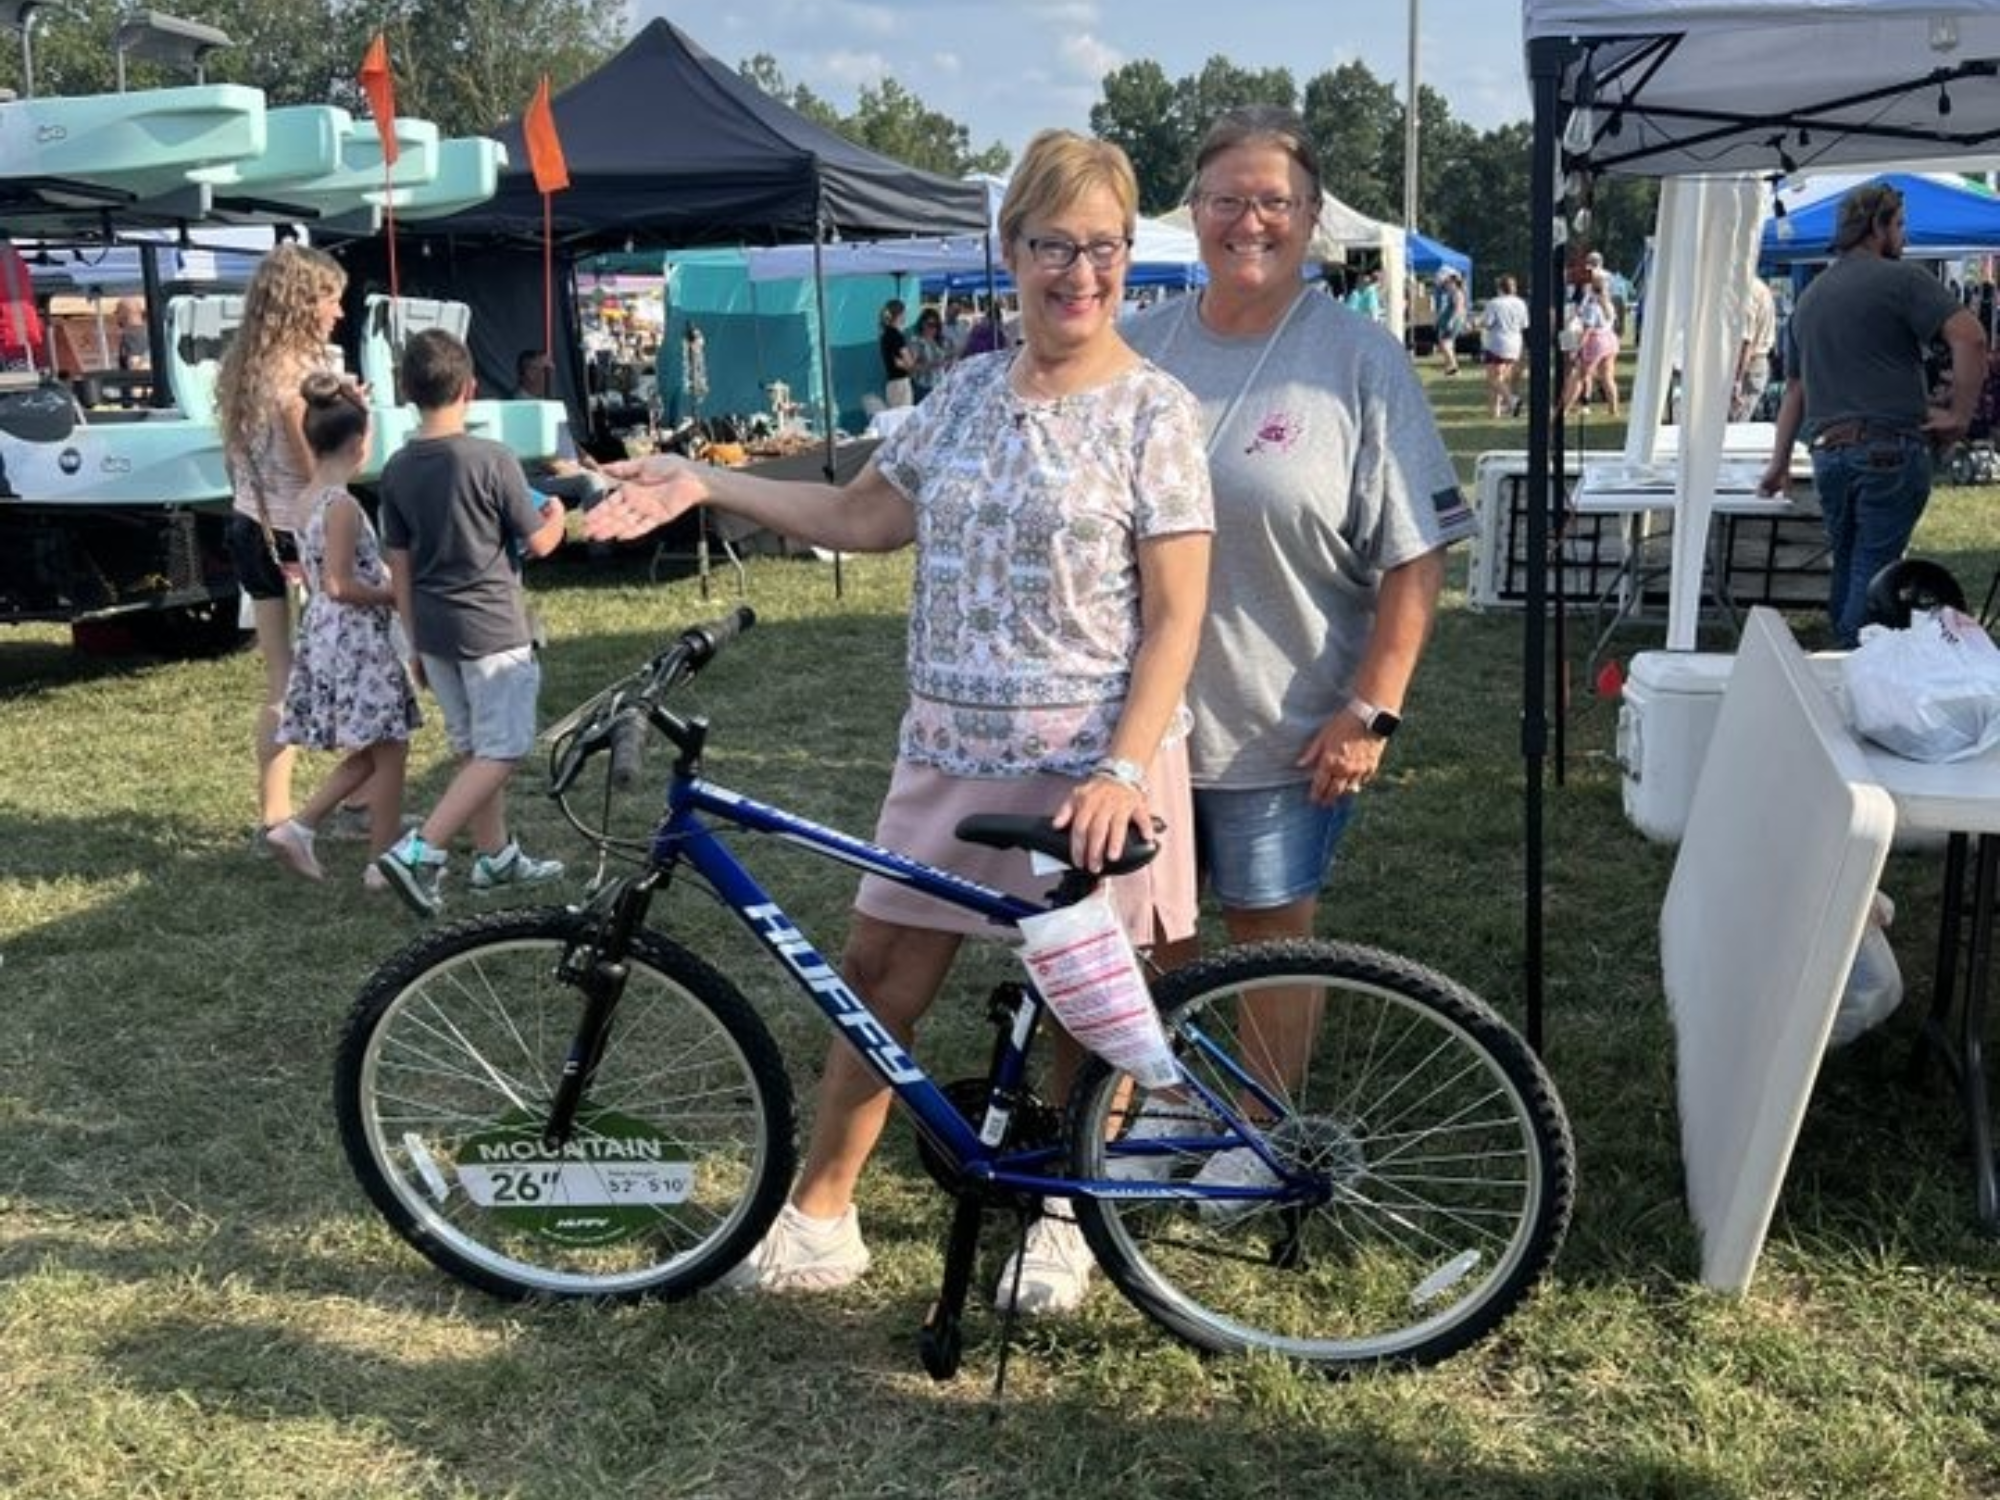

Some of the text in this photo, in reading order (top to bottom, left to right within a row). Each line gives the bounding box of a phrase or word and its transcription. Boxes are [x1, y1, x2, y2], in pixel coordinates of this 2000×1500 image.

[743, 902, 926, 1084] HUFFY
[476, 1136, 663, 1160] MOUNTAIN
[491, 1171, 560, 1201] 26"
